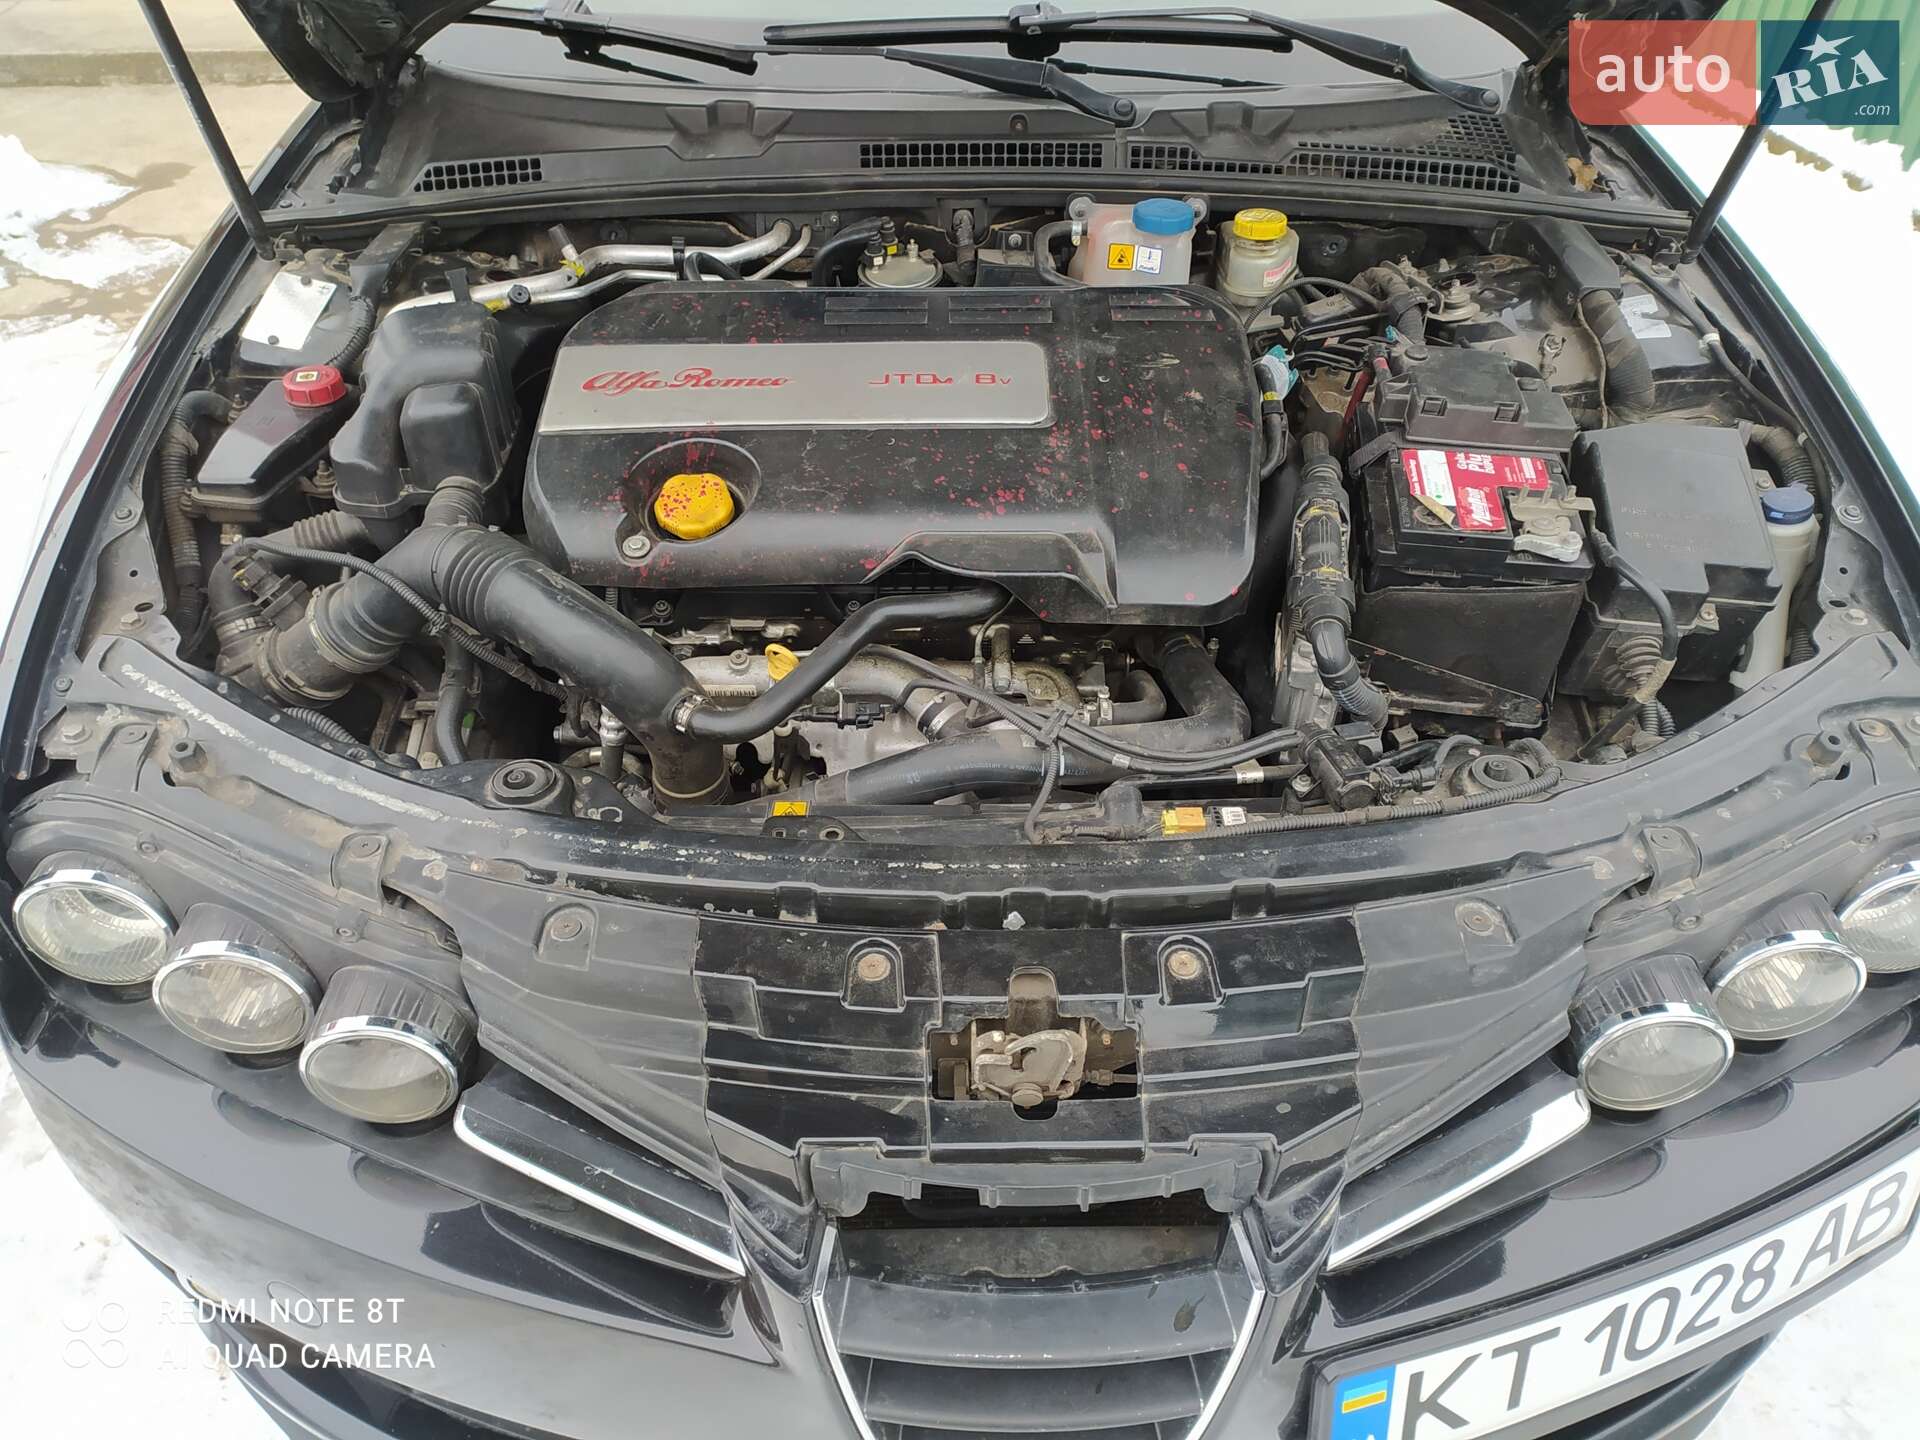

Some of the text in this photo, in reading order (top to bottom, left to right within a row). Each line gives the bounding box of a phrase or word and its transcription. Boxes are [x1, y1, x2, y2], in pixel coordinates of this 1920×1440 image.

[582, 367, 788, 397] Alfa Romeo
[1401, 1170, 1909, 1440] KT 1028 AB
